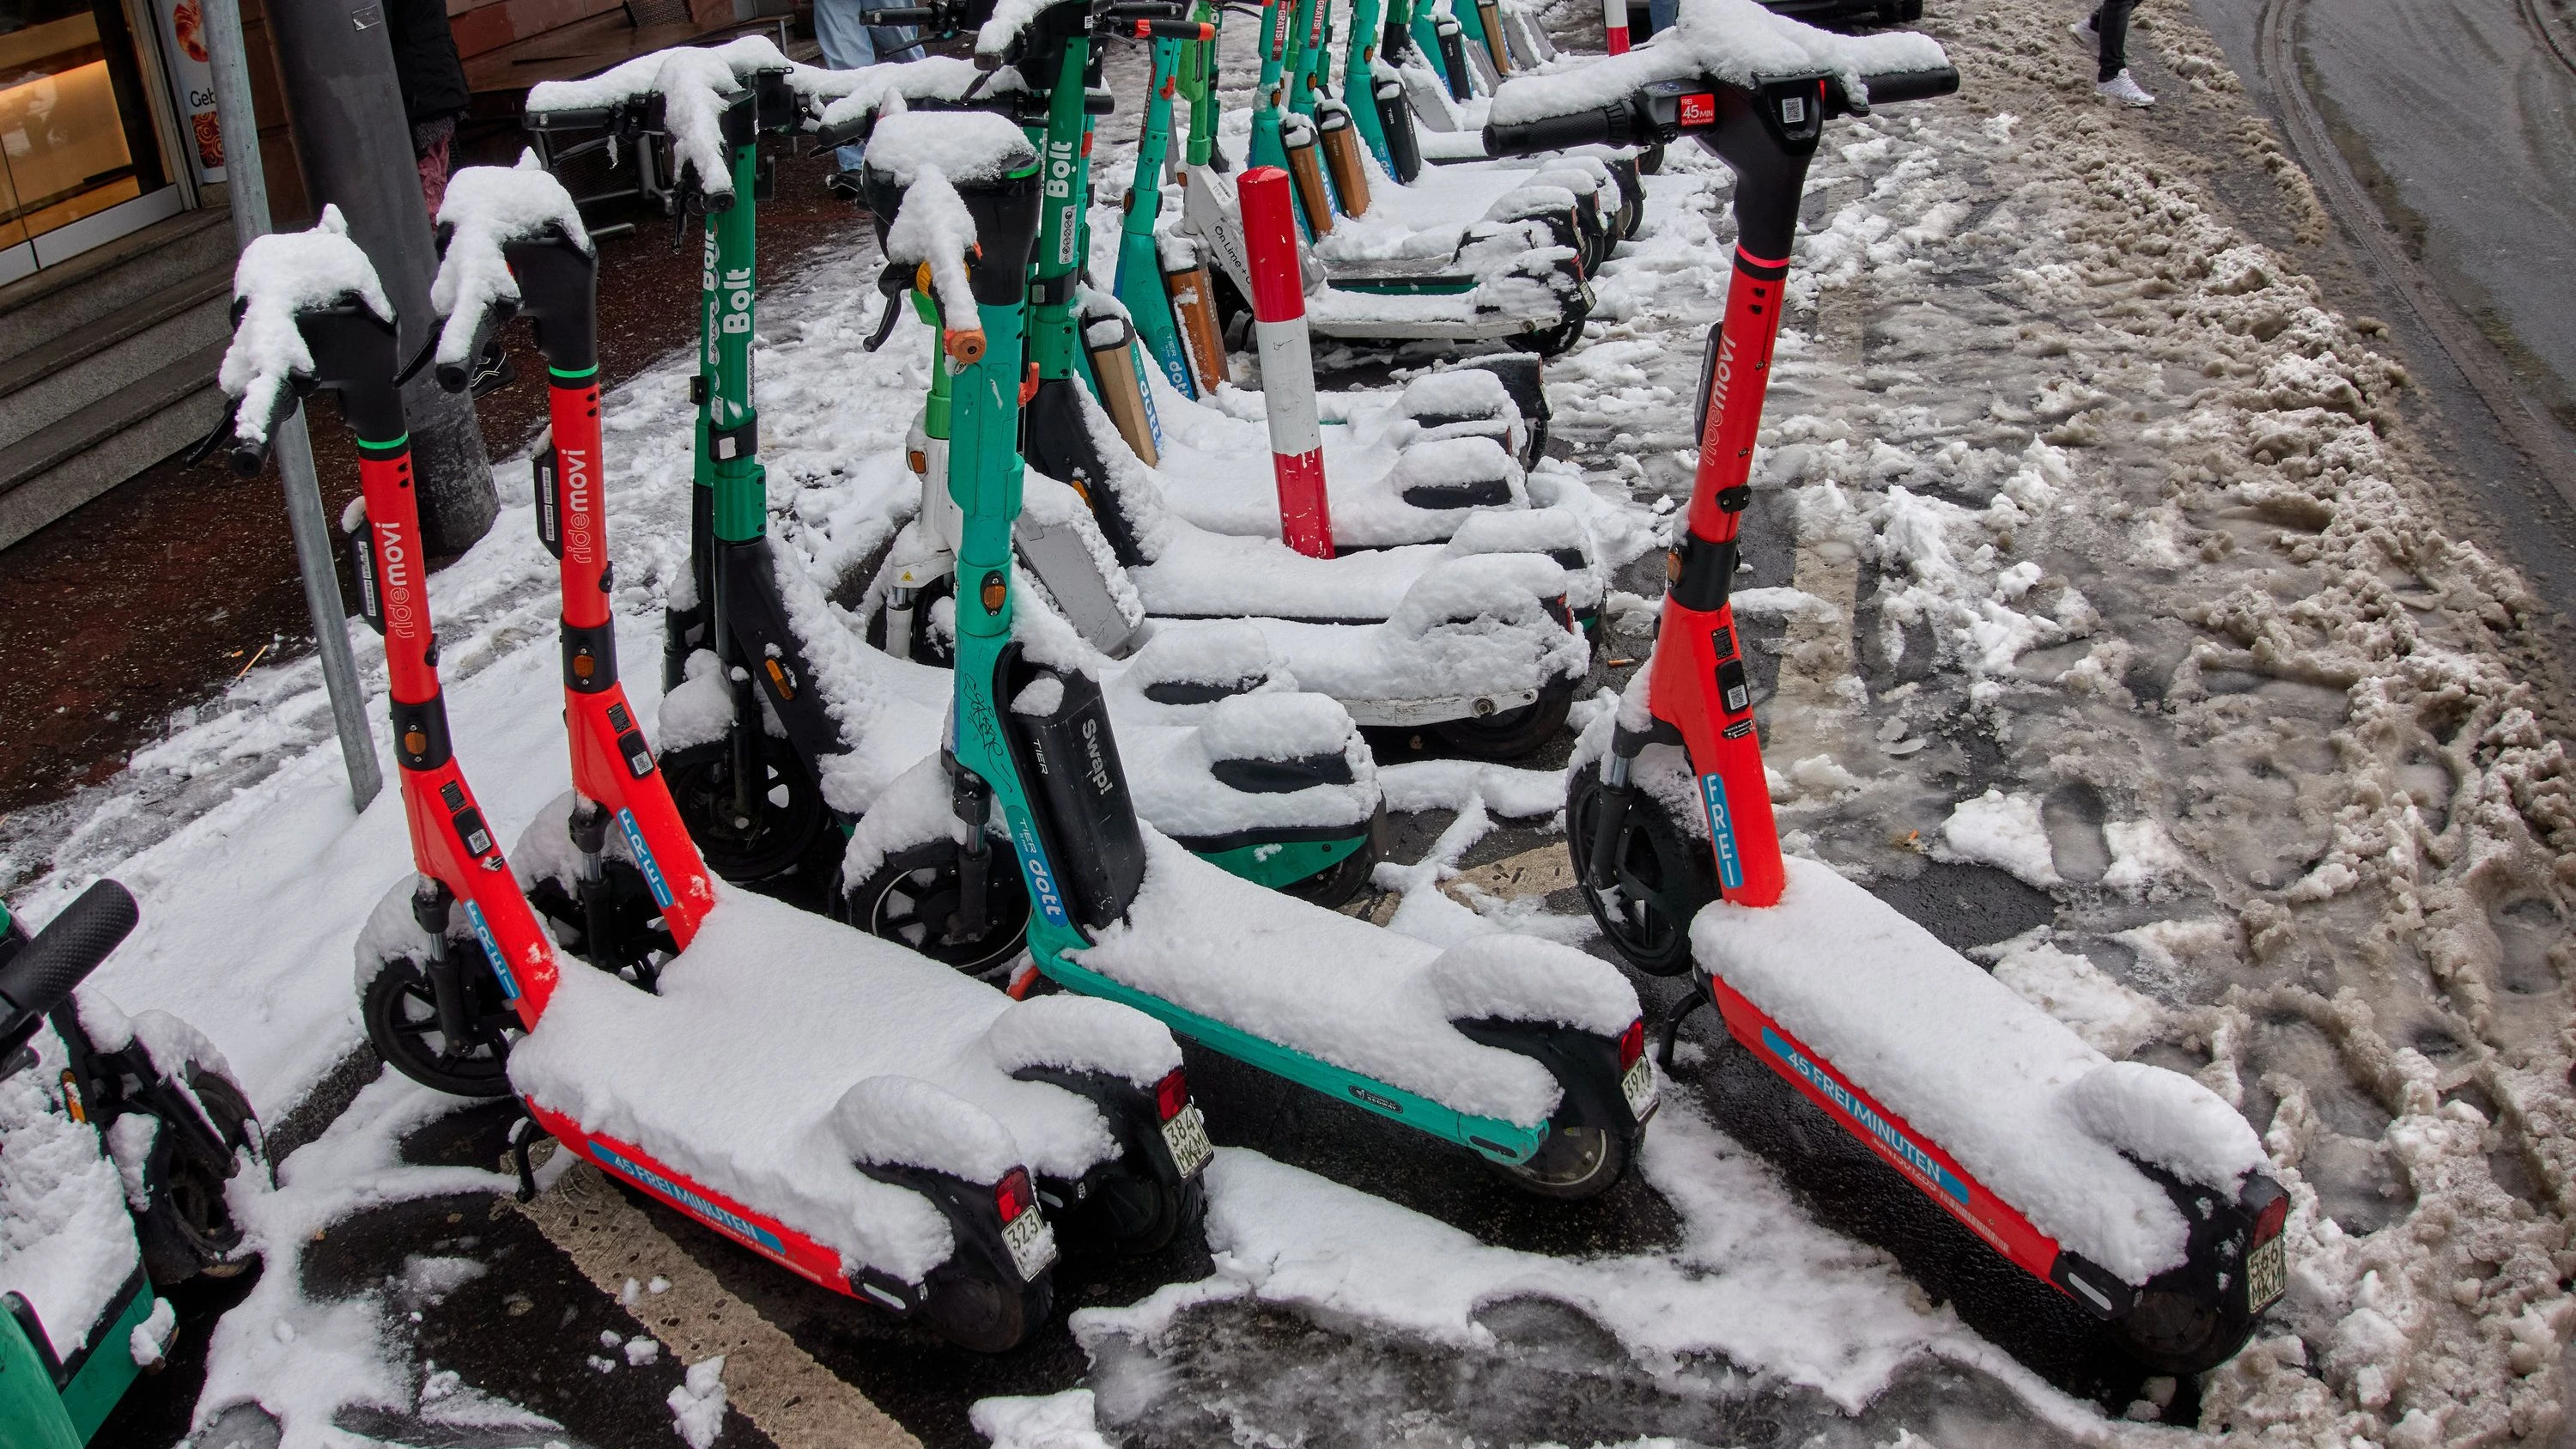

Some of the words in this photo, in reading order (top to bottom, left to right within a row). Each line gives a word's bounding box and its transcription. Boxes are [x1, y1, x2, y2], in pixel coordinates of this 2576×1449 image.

[1274, 9, 1286, 40] GRATIS!
[1683, 104, 1699, 119] 45
[1699, 109, 1713, 118] MIN
[1045, 141, 1072, 198] Bolt
[1214, 225, 1225, 243] On
[1224, 241, 1242, 268] Lime
[723, 267, 750, 333] Bolt
[1167, 332, 1177, 357] TIER
[1704, 331, 1736, 466] ridemovi
[561, 449, 592, 563] ridemovi
[374, 522, 415, 638] ridemovi
[1033, 739, 1048, 775] TIER
[1083, 718, 1114, 795] Swap!
[1019, 818, 1037, 854] TIER
[1706, 775, 1735, 886] FREI
[620, 808, 668, 905] FREI
[1028, 859, 1061, 916] dott
[466, 901, 516, 997] FREI
[1625, 1062, 1644, 1099] 397
[1166, 1111, 1195, 1148] 384
[1788, 1051, 1809, 1076] 45
[1813, 1066, 1850, 1110] FREI
[1854, 1100, 1941, 1184] MINUTEN
[1176, 1132, 1207, 1172] MKM
[615, 1155, 635, 1177] 45
[638, 1166, 673, 1196] FREI
[672, 1187, 759, 1240] MINUTEN
[1006, 1212, 1039, 1251] 323
[2250, 1240, 2278, 1278] 566
[2251, 1266, 2281, 1307] MKM
